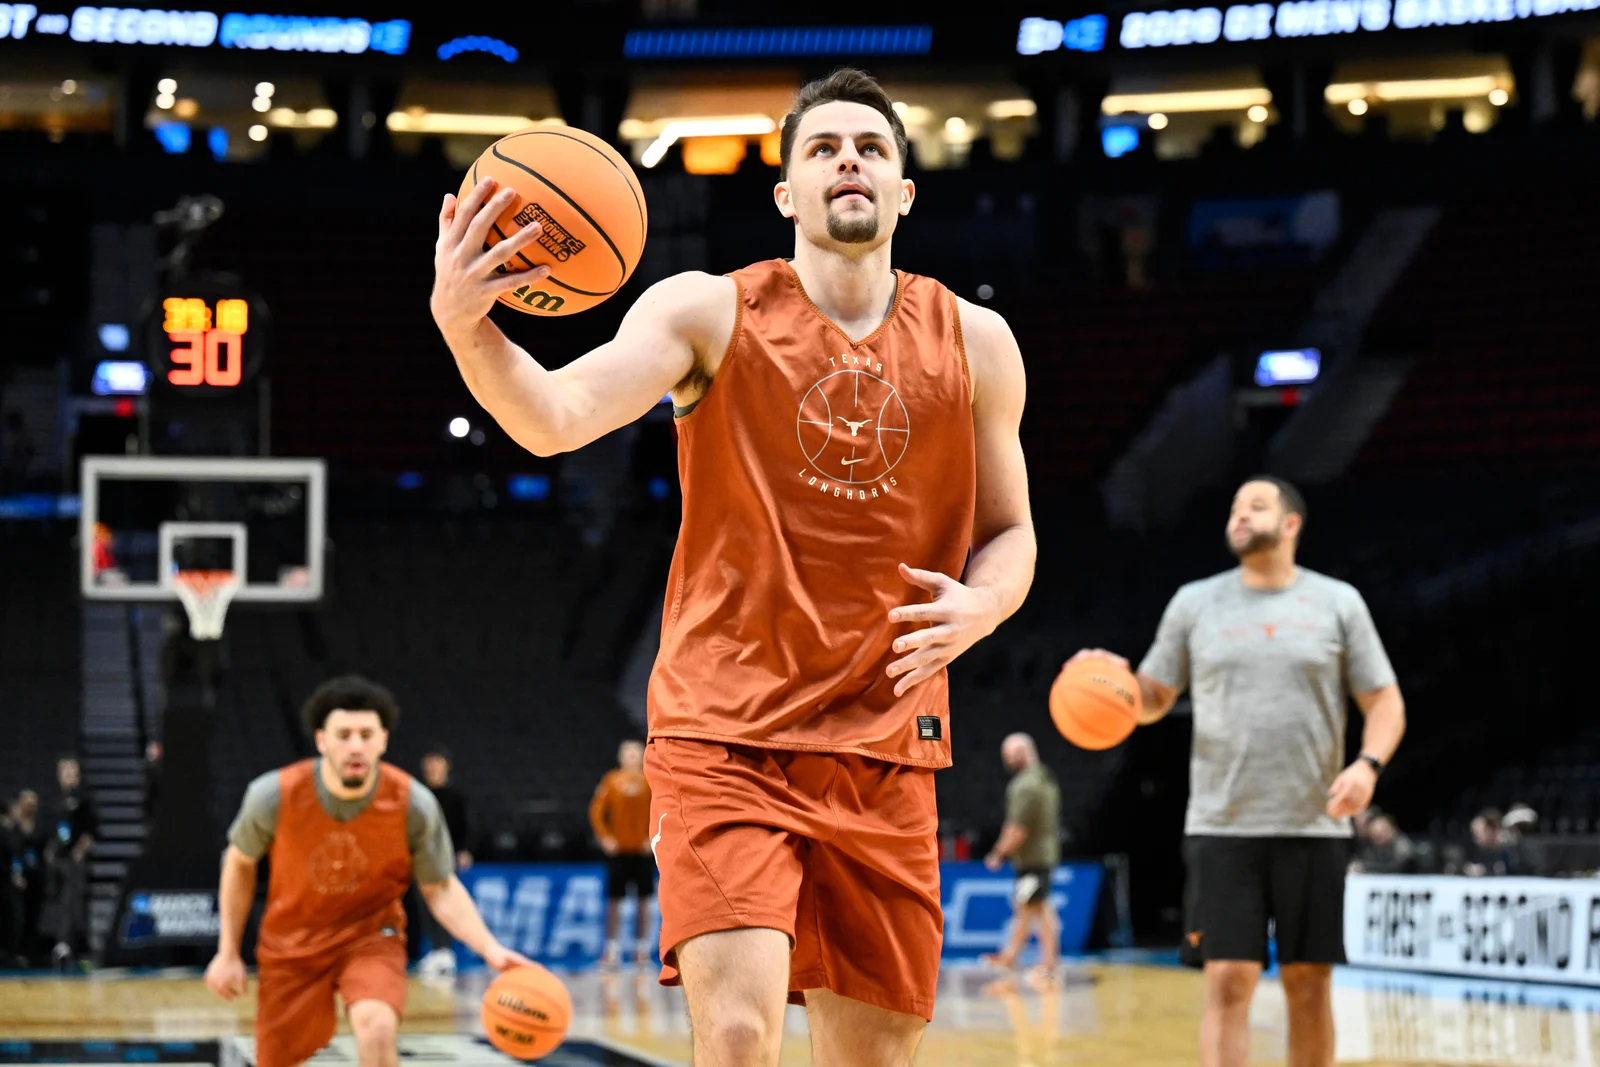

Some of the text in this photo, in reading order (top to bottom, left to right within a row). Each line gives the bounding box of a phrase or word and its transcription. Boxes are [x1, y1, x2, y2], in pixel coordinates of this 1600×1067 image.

[168, 328, 242, 387] 30
[829, 354, 882, 372] TEXAS
[798, 468, 897, 500] LONGHORNS
[1364, 889, 1434, 957] FIRST
[1459, 893, 1574, 970] SECOND
